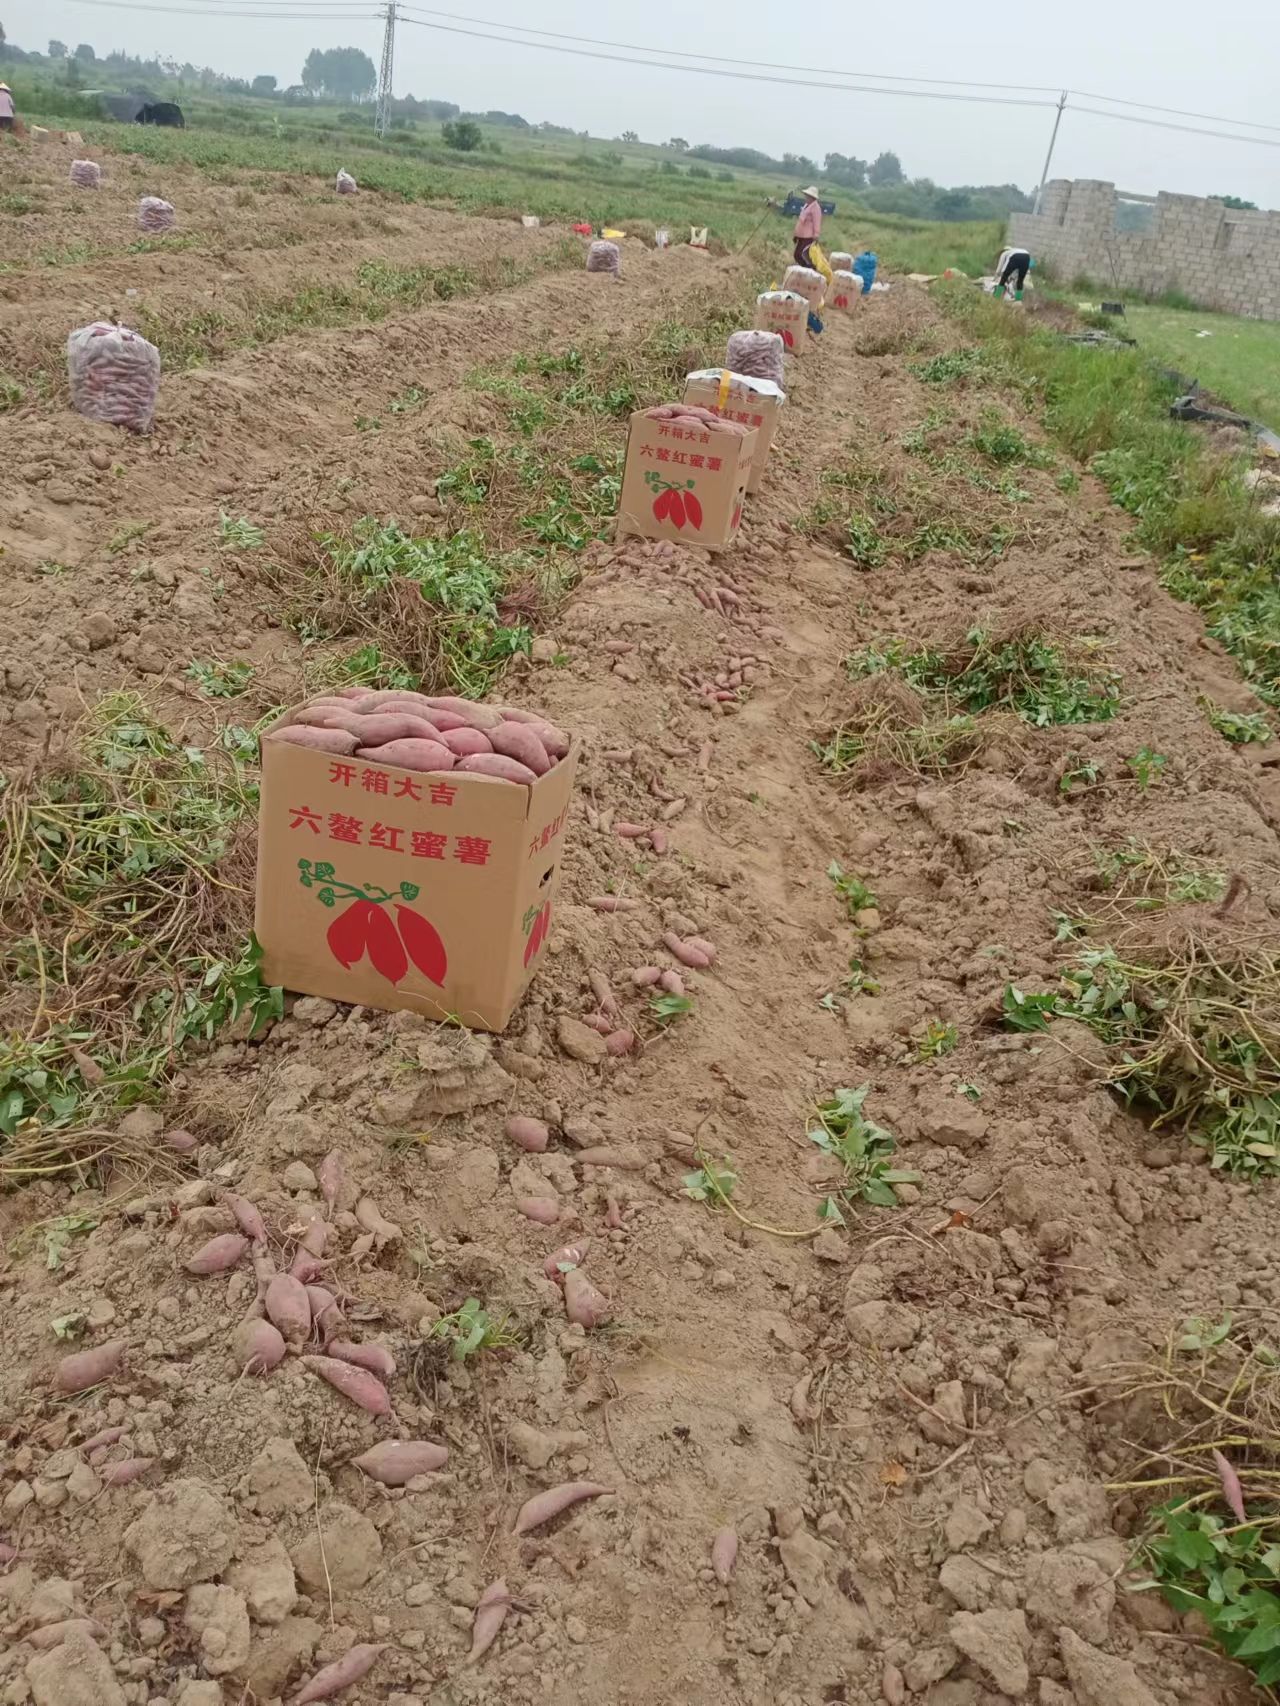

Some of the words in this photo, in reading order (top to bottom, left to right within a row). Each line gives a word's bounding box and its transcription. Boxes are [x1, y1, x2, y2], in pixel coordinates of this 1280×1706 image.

[658, 425, 711, 444] 开箱大吉
[640, 445, 723, 471] 六鳌红蜜薯
[329, 761, 458, 806] 开箱大吉
[288, 806, 492, 866] 六鳌红蜜薯
